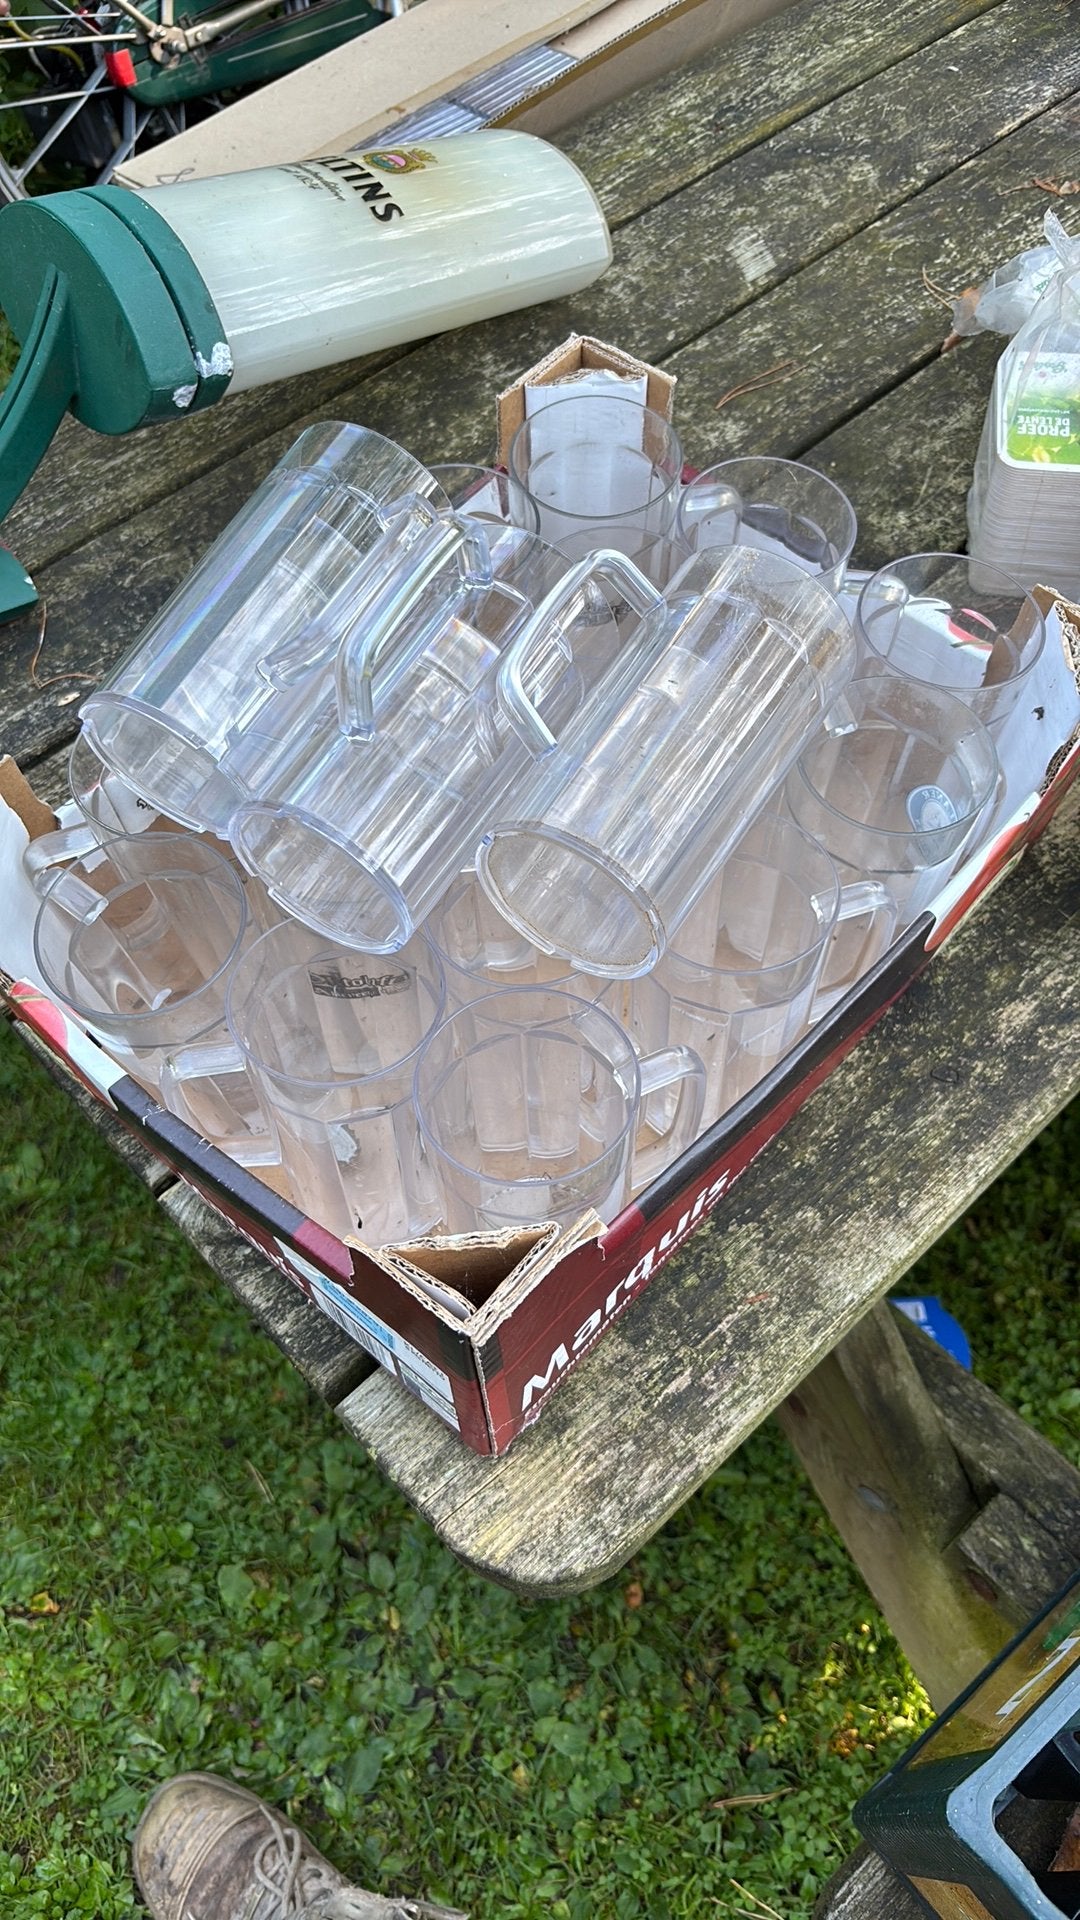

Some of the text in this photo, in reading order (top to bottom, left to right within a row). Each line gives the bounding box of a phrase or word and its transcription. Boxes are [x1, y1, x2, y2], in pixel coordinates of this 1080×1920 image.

[304, 156, 405, 222] LTINS
[1016, 415, 1070, 426] DE LENTE
[1016, 423, 1070, 437] PROEF
[521, 1168, 731, 1412] Marquis
